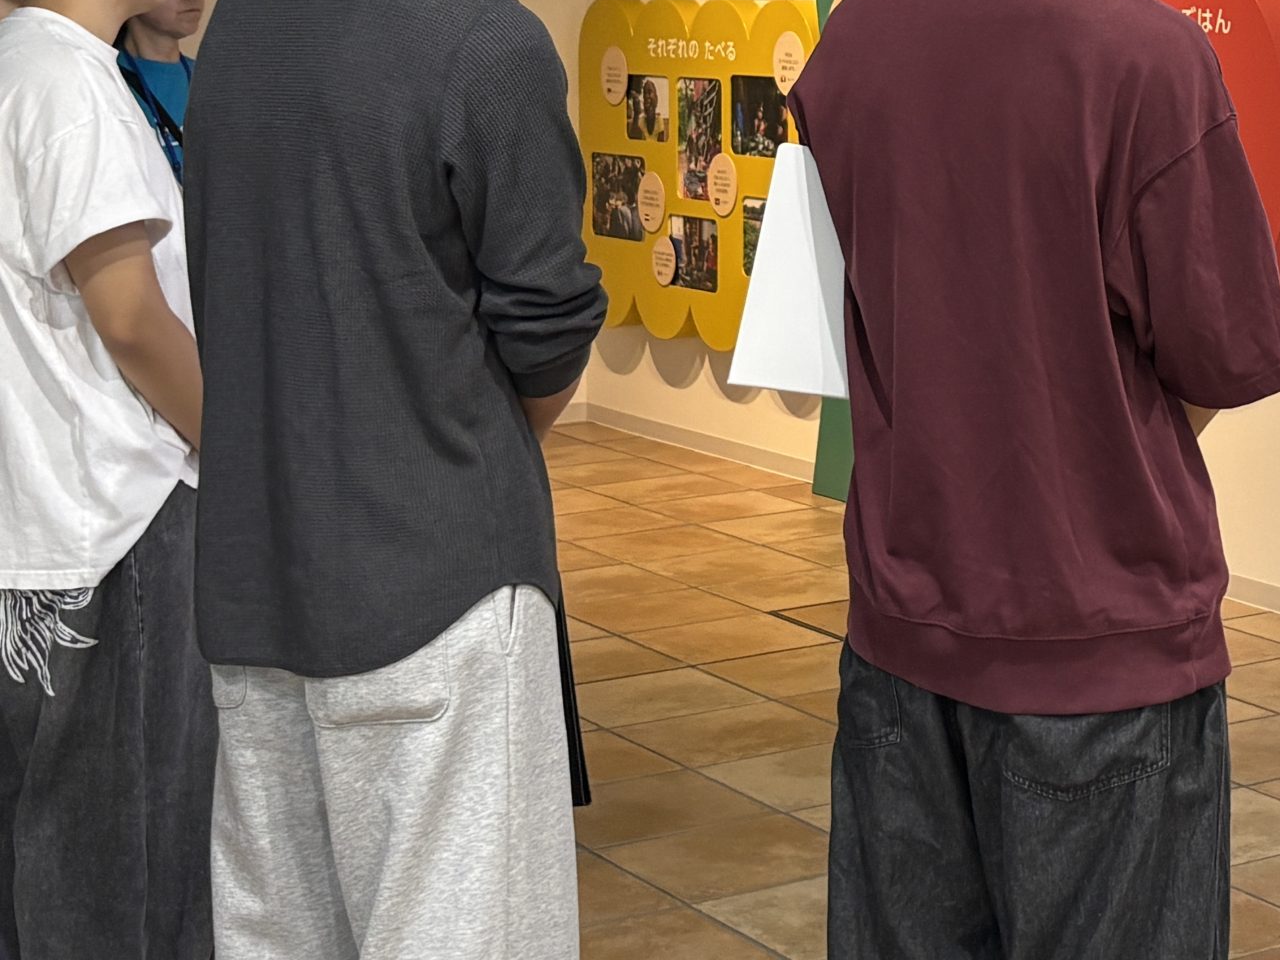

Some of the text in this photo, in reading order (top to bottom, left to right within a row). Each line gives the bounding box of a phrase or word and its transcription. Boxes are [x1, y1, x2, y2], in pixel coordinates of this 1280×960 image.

[647, 37, 736, 61] それぞれの たべる
